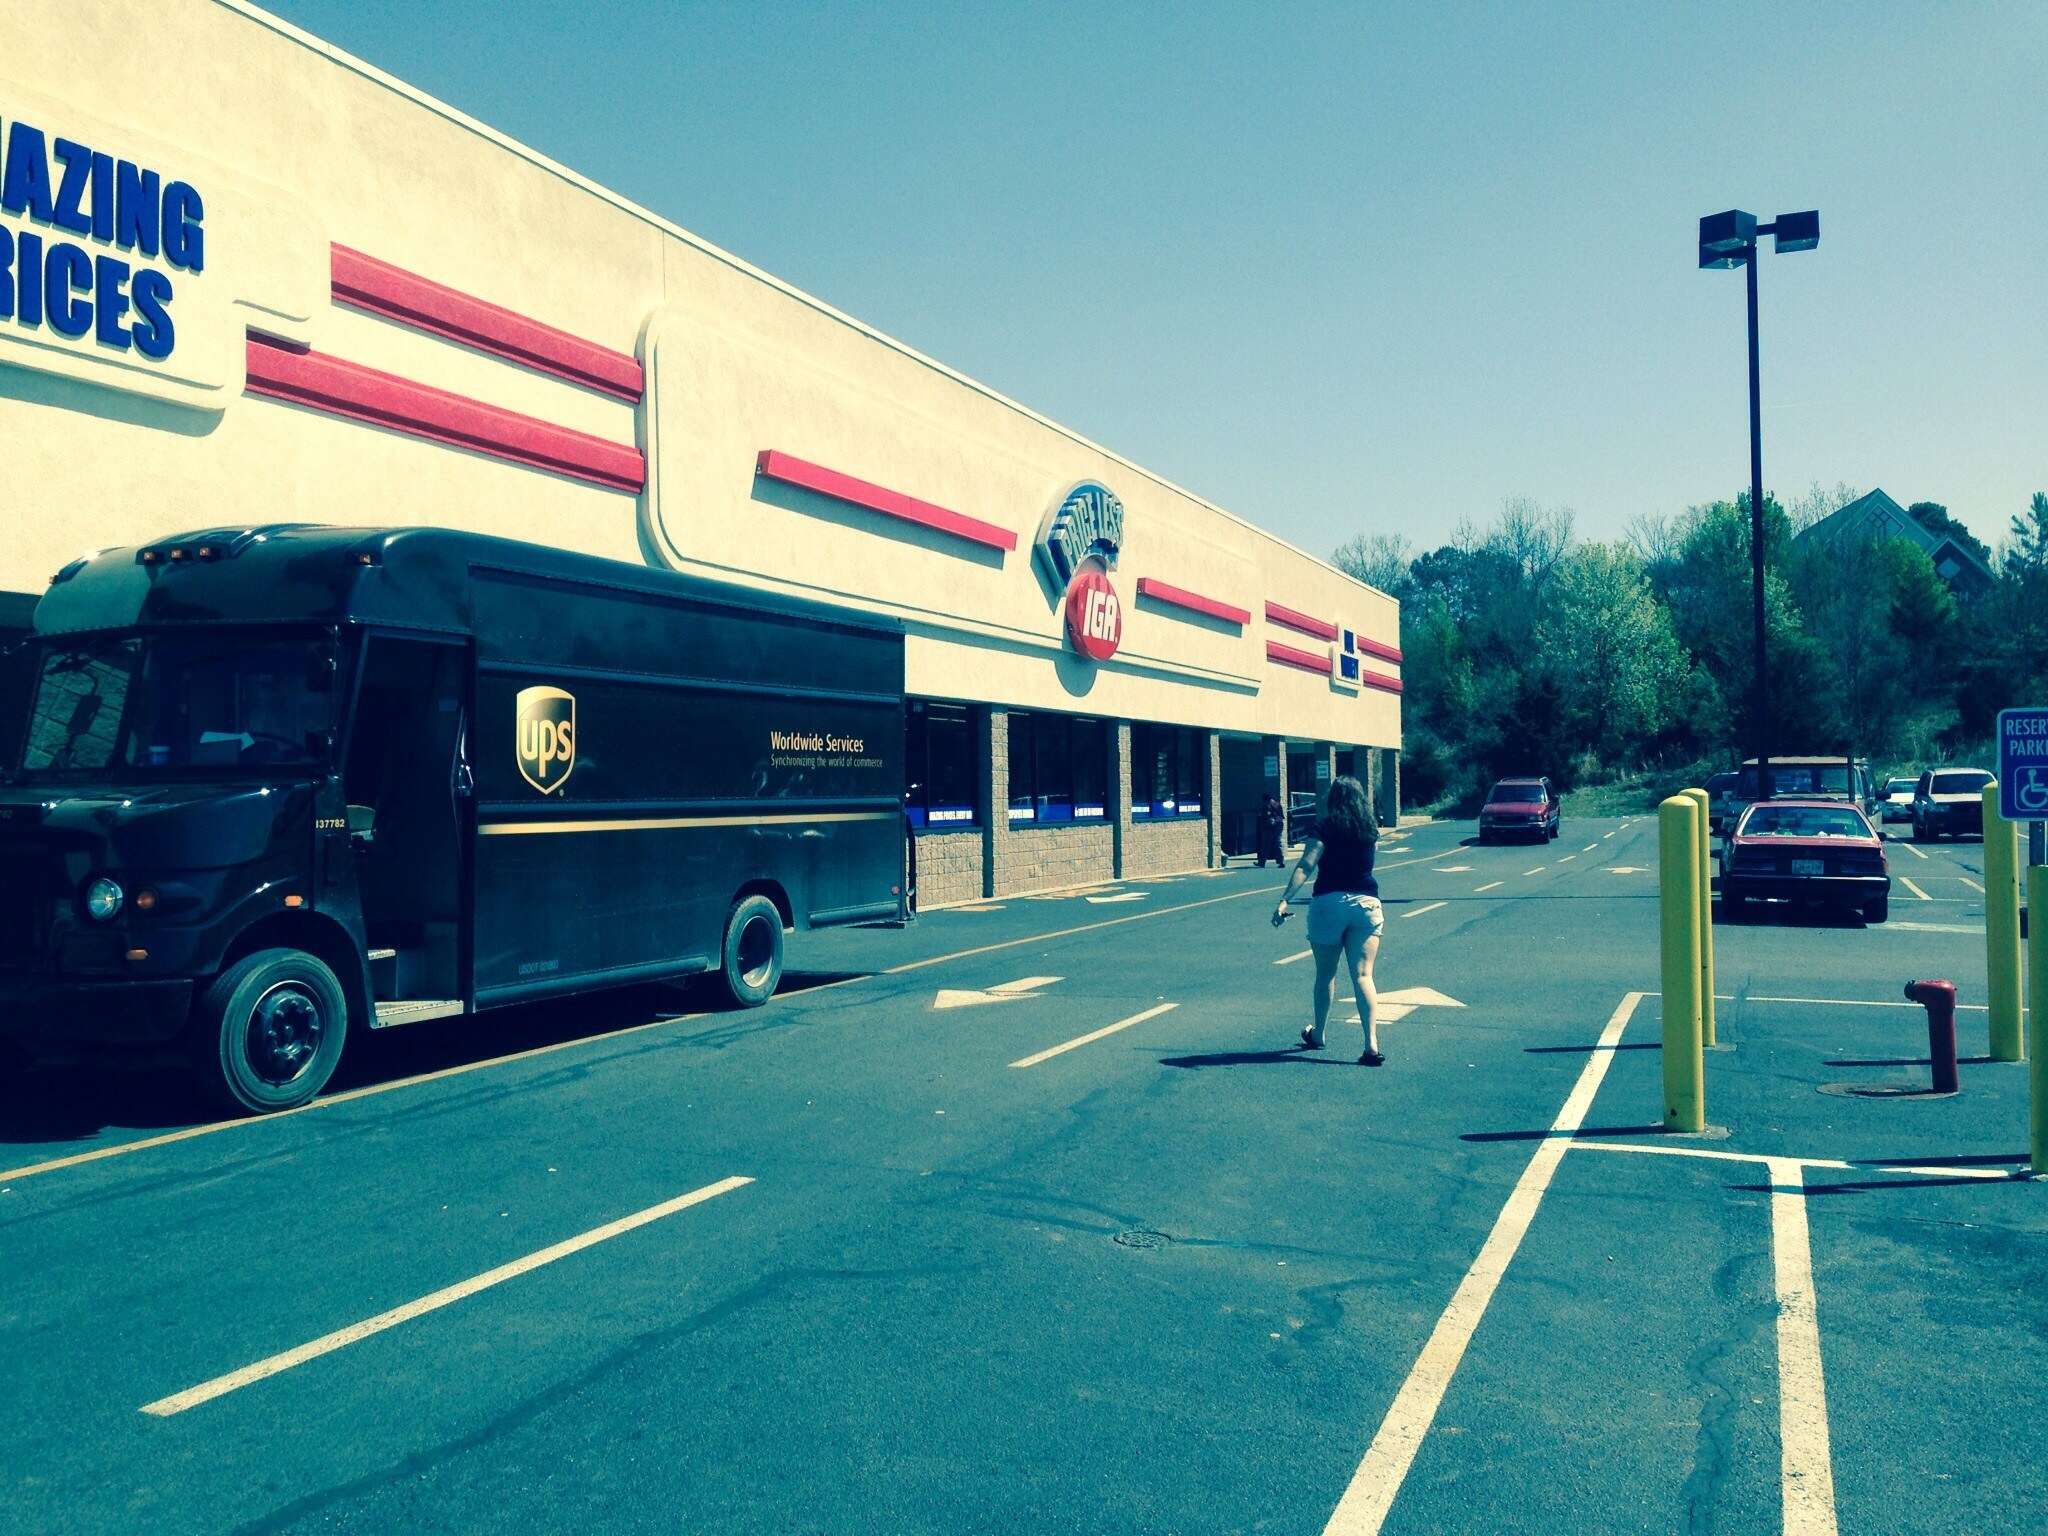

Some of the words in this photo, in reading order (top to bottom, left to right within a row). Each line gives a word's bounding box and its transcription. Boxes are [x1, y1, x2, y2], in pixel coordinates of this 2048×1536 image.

[0, 119, 204, 275] AZING
[0, 224, 175, 362] ICES
[1055, 491, 1098, 573] PRICE
[770, 731, 823, 751] Worldwide
[826, 733, 864, 752] Services
[2006, 719, 2048, 735] RESER
[521, 719, 572, 778] ups
[771, 753, 816, 769] Synchronizing
[816, 756, 827, 767] the
[828, 756, 845, 767] world
[846, 756, 853, 767] of
[853, 758, 883, 767] commerce
[316, 819, 345, 828] 137782
